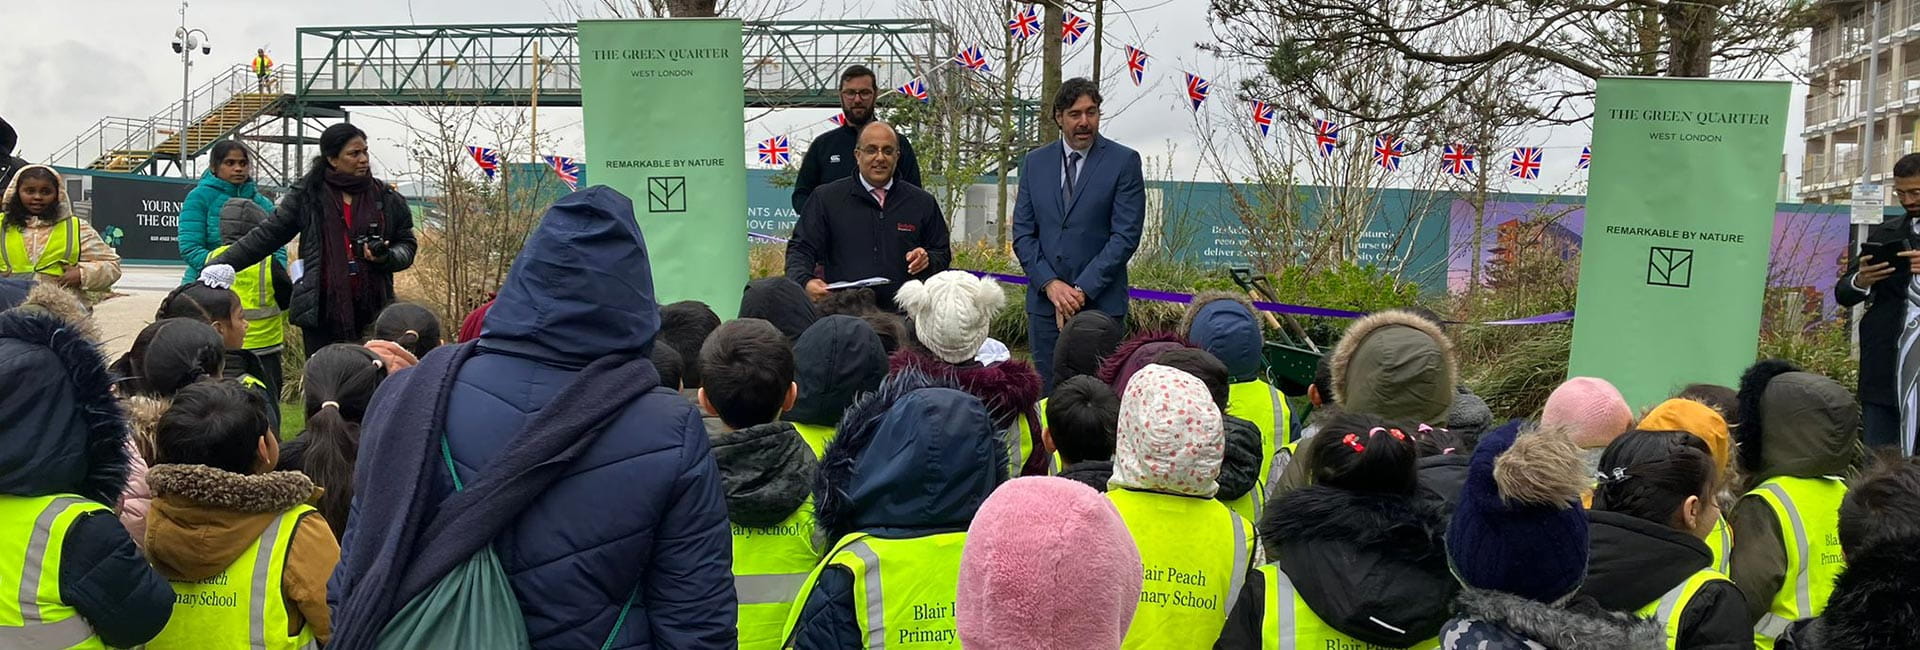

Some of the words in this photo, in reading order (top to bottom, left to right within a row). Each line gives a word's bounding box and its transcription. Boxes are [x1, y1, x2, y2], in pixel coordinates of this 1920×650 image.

[592, 49, 619, 60] THE
[622, 49, 666, 60] GREEN
[669, 48, 729, 62] QUARTER
[631, 70, 655, 78] WEST
[658, 69, 693, 77] LONDON
[1609, 109, 1639, 121] THE
[1642, 110, 1693, 122] GREEN
[1696, 111, 1769, 126] QUARTER
[1650, 132, 1677, 141] WEST
[1680, 134, 1722, 142] LONDON
[606, 160, 671, 169] REMARKABLE
[673, 159, 686, 168] BY
[687, 158, 725, 167] NATURE
[142, 200, 171, 213] YOUR
[136, 214, 159, 227] THE
[746, 219, 774, 230] OVE
[1606, 225, 1680, 239] REMARKABLE
[1681, 231, 1697, 240] BY
[1699, 232, 1745, 243] NATURE
[1824, 533, 1838, 546] Bla
[1167, 567, 1206, 587] Peach
[199, 591, 237, 608] School
[1172, 590, 1217, 611] School
[913, 602, 947, 621] Blair
[899, 627, 957, 645] Primary
